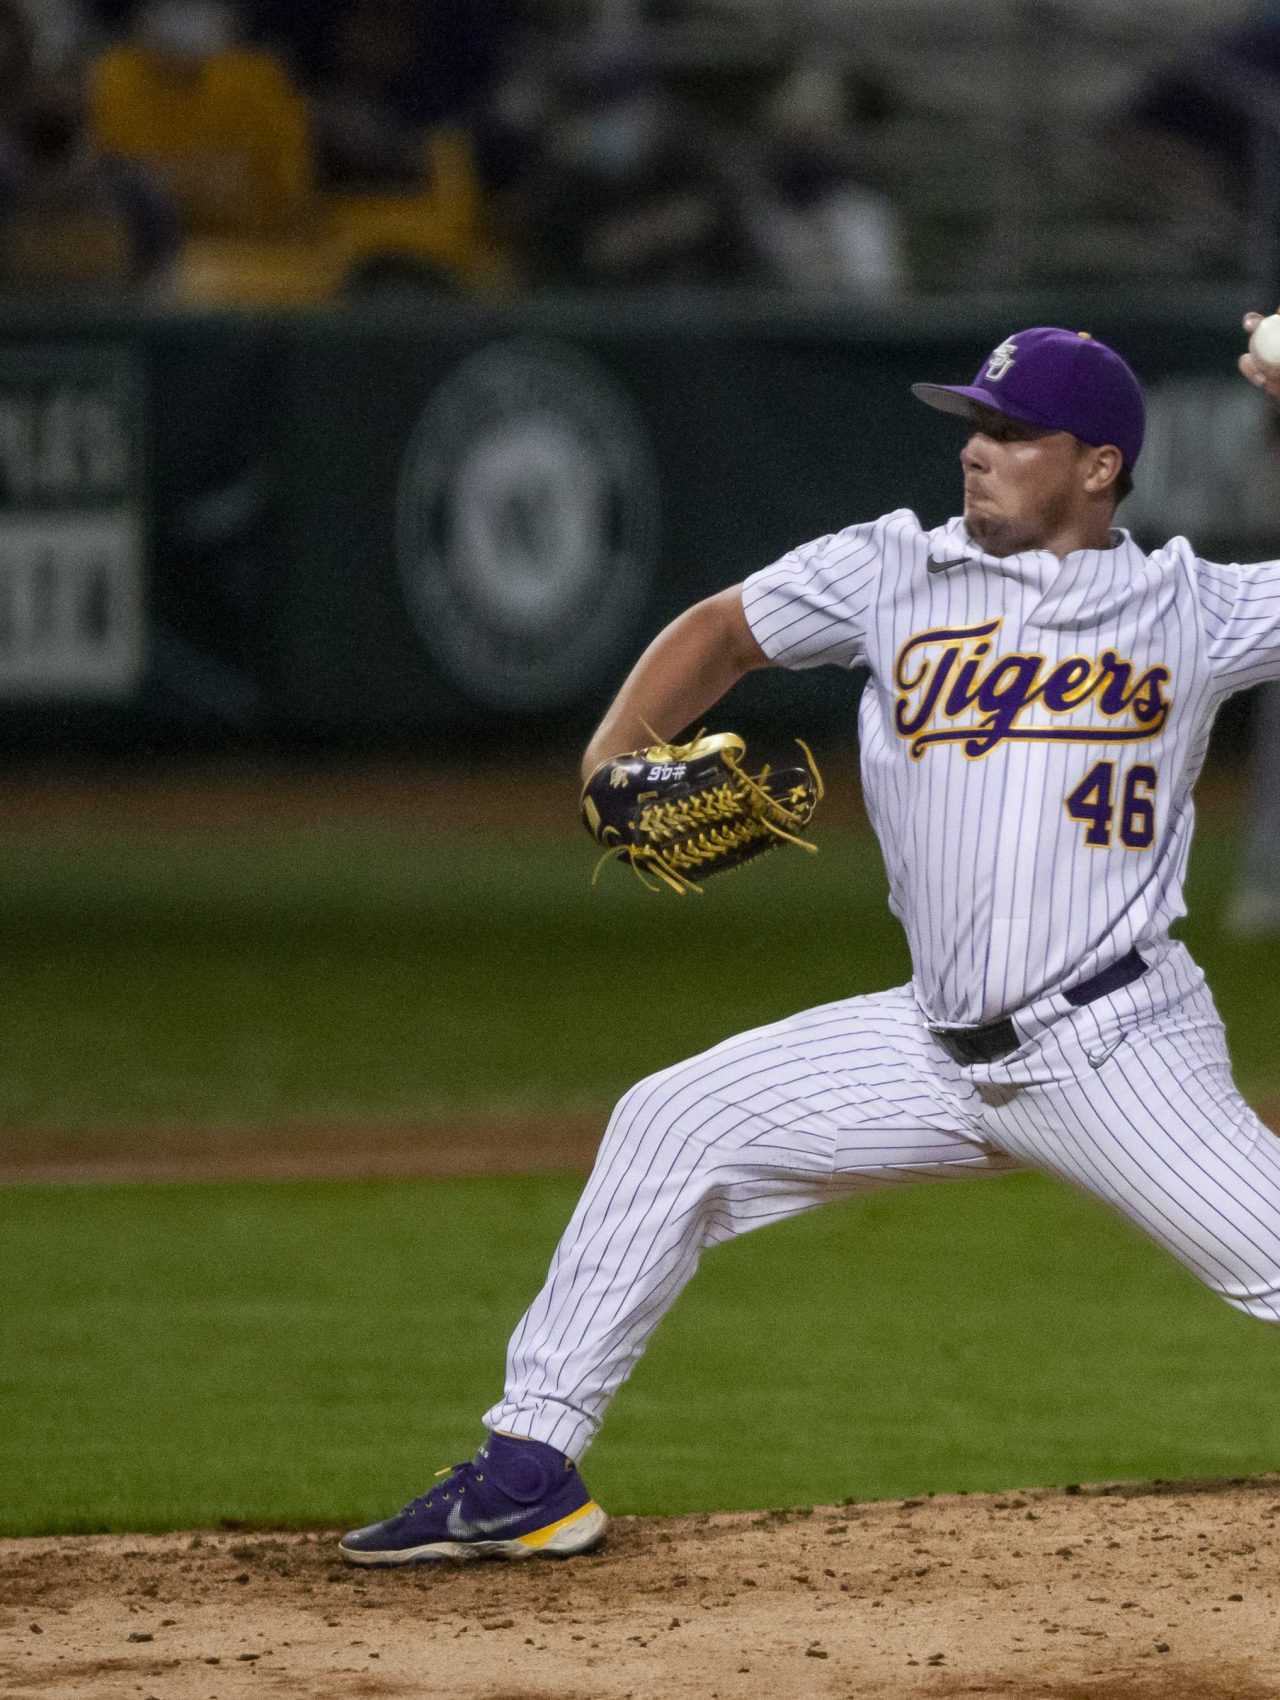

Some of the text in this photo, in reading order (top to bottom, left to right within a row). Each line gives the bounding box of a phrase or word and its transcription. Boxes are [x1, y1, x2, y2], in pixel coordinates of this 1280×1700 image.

[895, 616, 1172, 762] Tigers
[647, 763, 687, 781] #46
[1065, 759, 1160, 850] 46
